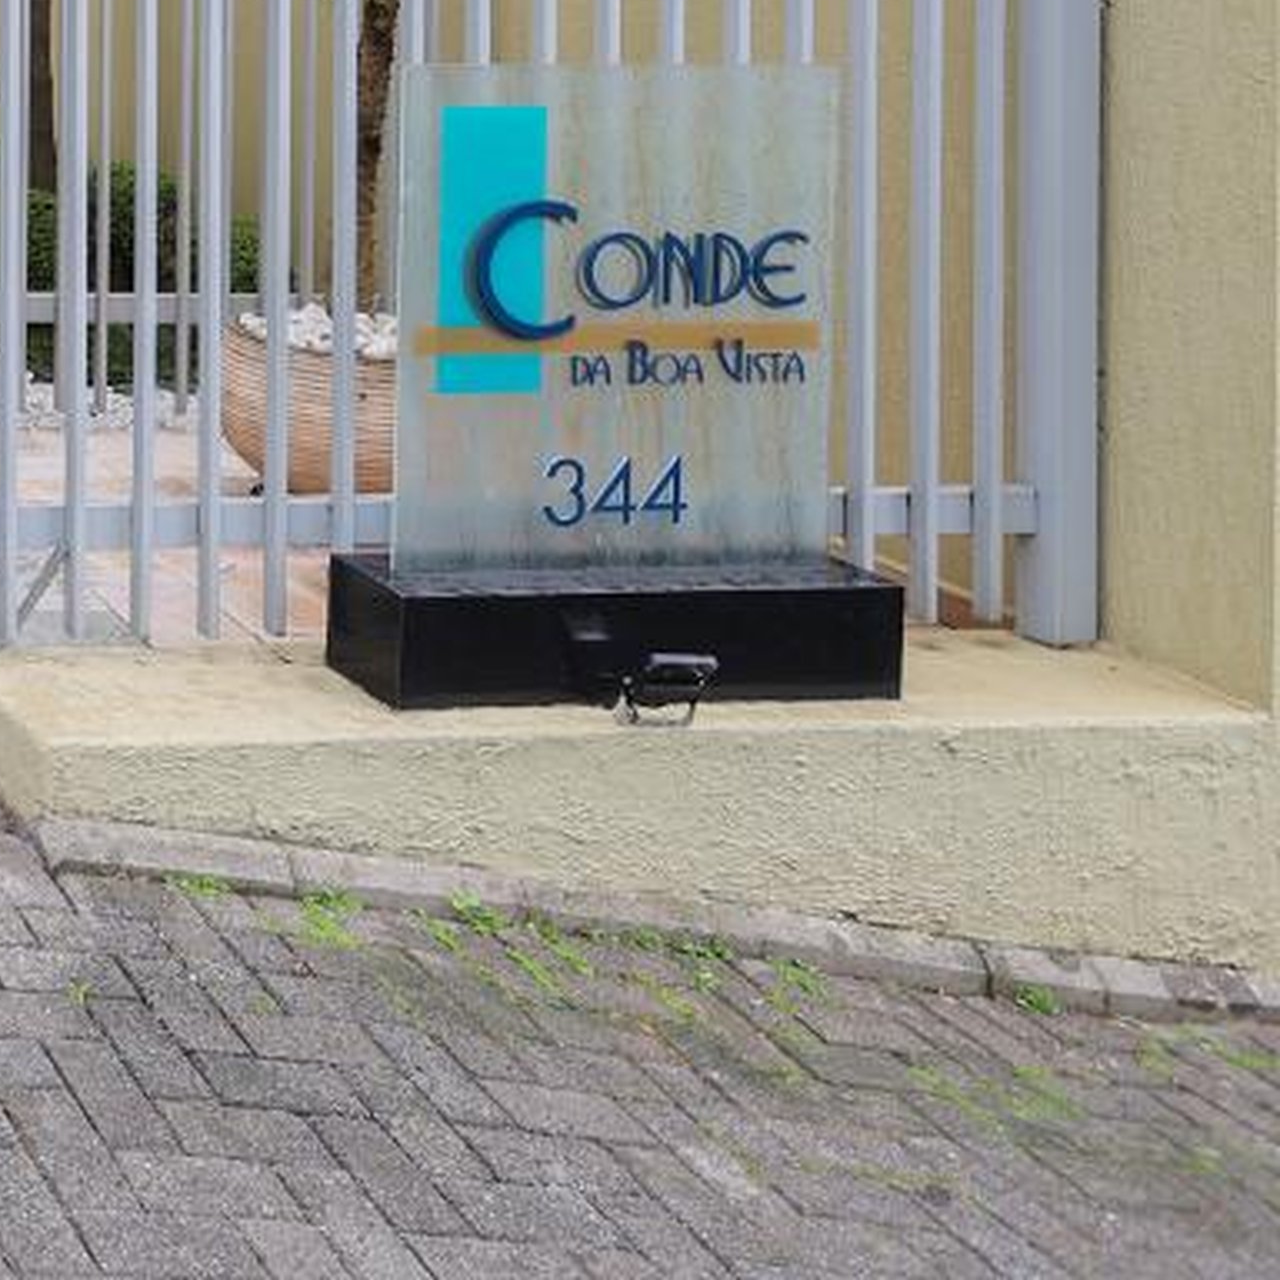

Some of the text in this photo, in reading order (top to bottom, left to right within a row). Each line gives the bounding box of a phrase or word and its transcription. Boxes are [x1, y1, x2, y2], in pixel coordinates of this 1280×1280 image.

[474, 200, 810, 340] CONDE
[570, 338, 806, 387] DA BOA VISTA
[542, 455, 688, 528] 344
